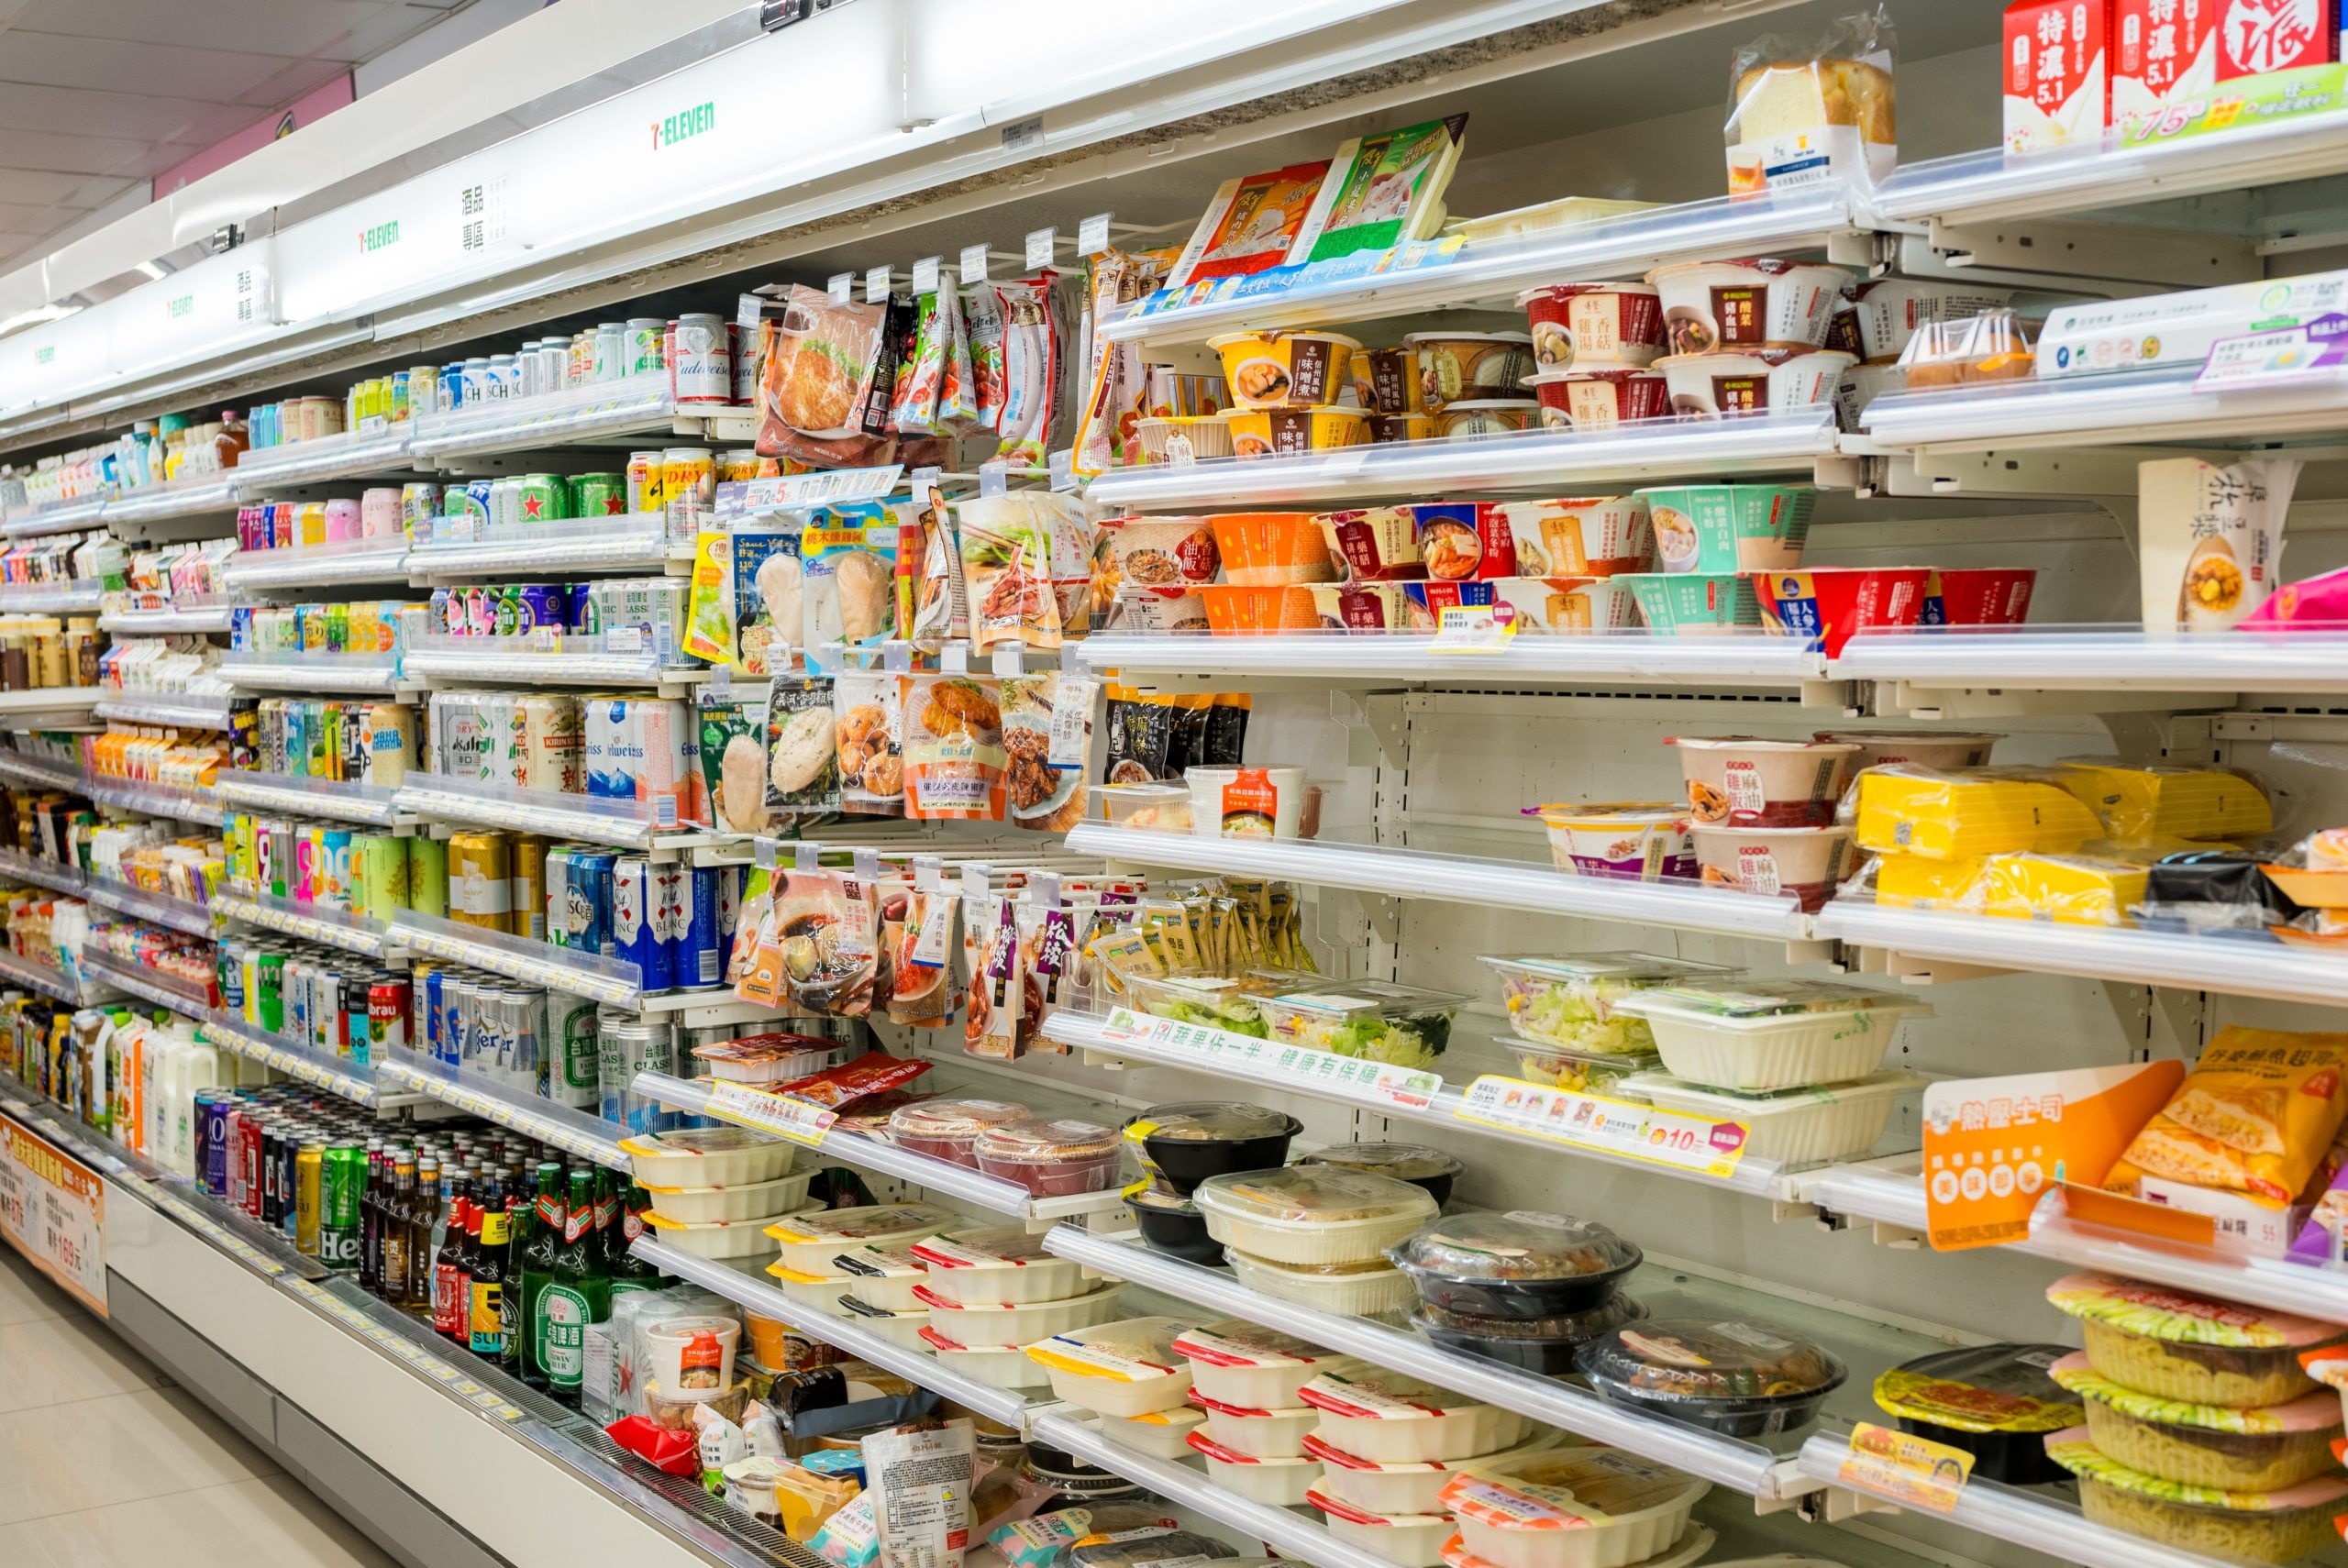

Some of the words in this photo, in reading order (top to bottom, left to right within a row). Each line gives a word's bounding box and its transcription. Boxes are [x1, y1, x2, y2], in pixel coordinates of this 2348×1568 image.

[2037, 9, 2067, 81] 特濃
[2146, 61, 2175, 86] 5.1
[2036, 81, 2065, 105] 5.1
[650, 101, 714, 150] 7-ELEVEN
[461, 184, 484, 216] 酒品
[358, 219, 399, 254] 7-ELEVEN
[1739, 301, 1753, 327] 酸菜
[1577, 318, 1592, 351] 雞湯
[1596, 317, 1611, 350] 香菇
[1298, 359, 1313, 397] 味噌煮
[1182, 541, 1198, 571] 油飯
[1201, 542, 1213, 572] 香菇
[1176, 1025, 1262, 1063] 蔬果佔一半
[1276, 1048, 1381, 1086] 健康有保障
